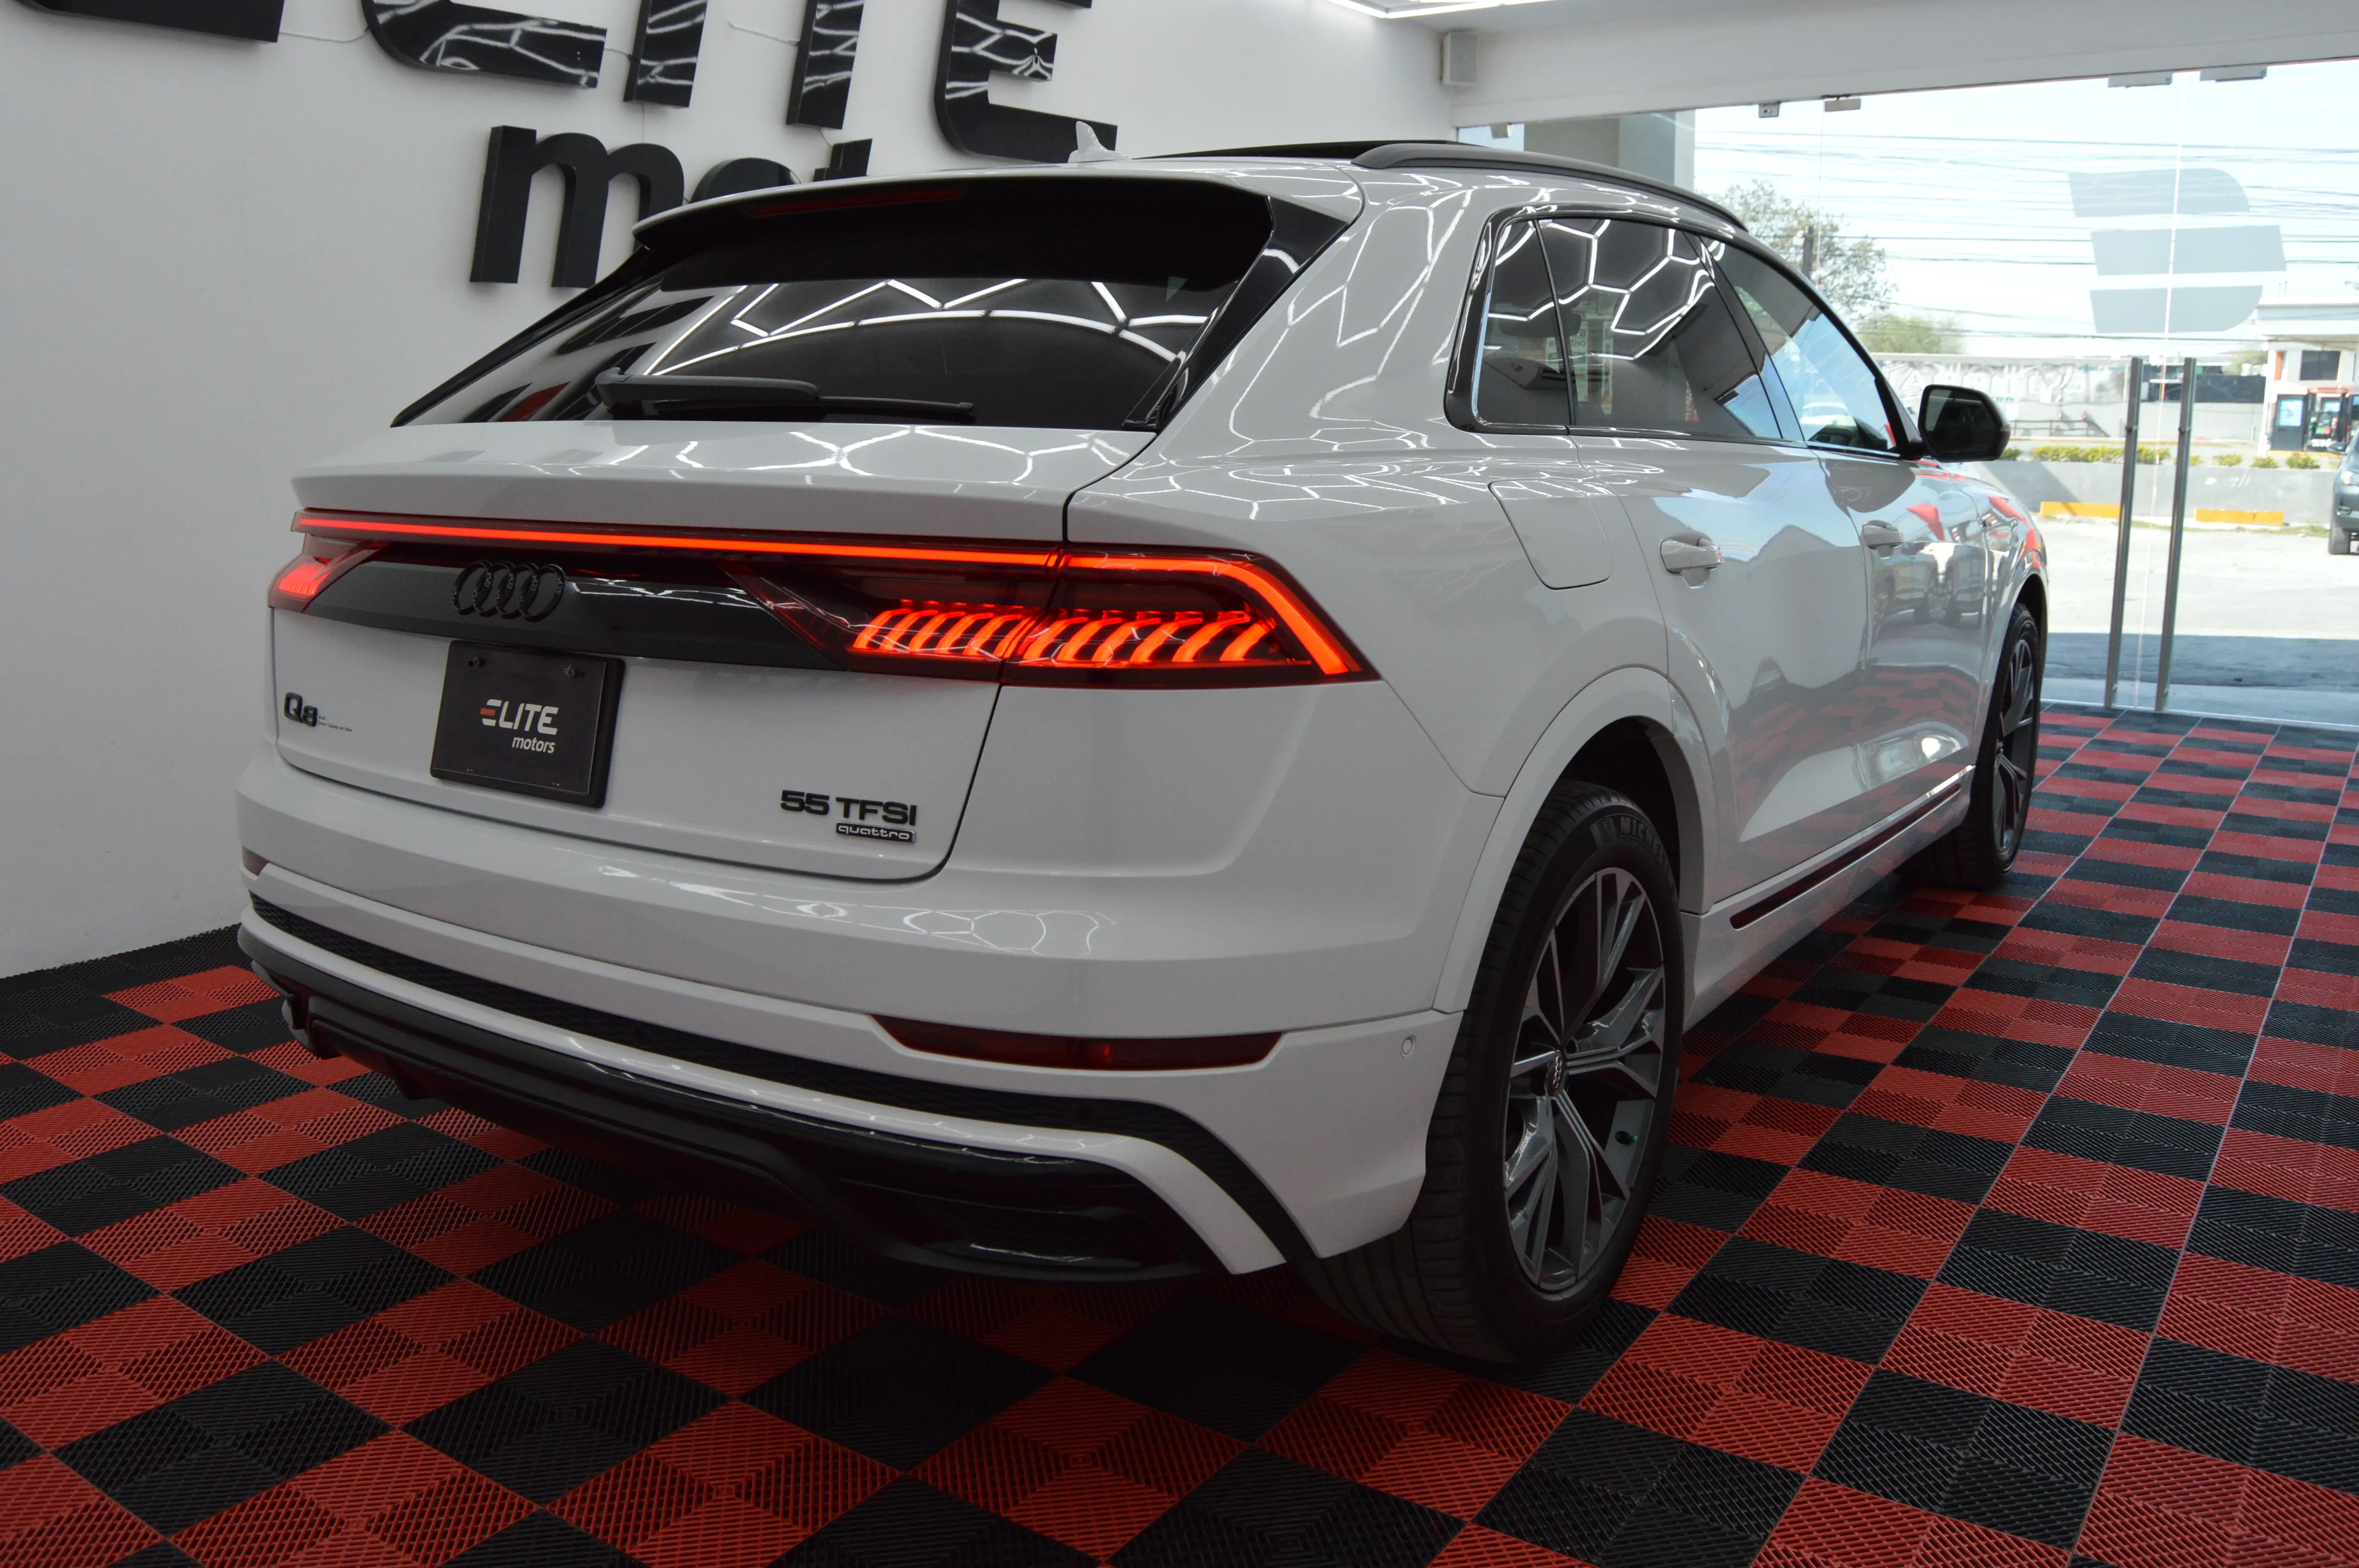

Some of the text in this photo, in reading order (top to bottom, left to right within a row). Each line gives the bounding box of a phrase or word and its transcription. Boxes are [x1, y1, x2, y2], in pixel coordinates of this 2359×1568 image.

[284, 692, 317, 727] Q8
[479, 699, 559, 735] ELITE
[511, 737, 555, 754] motors
[781, 790, 917, 826] 55 TFSI
[838, 824, 910, 840] quattro
